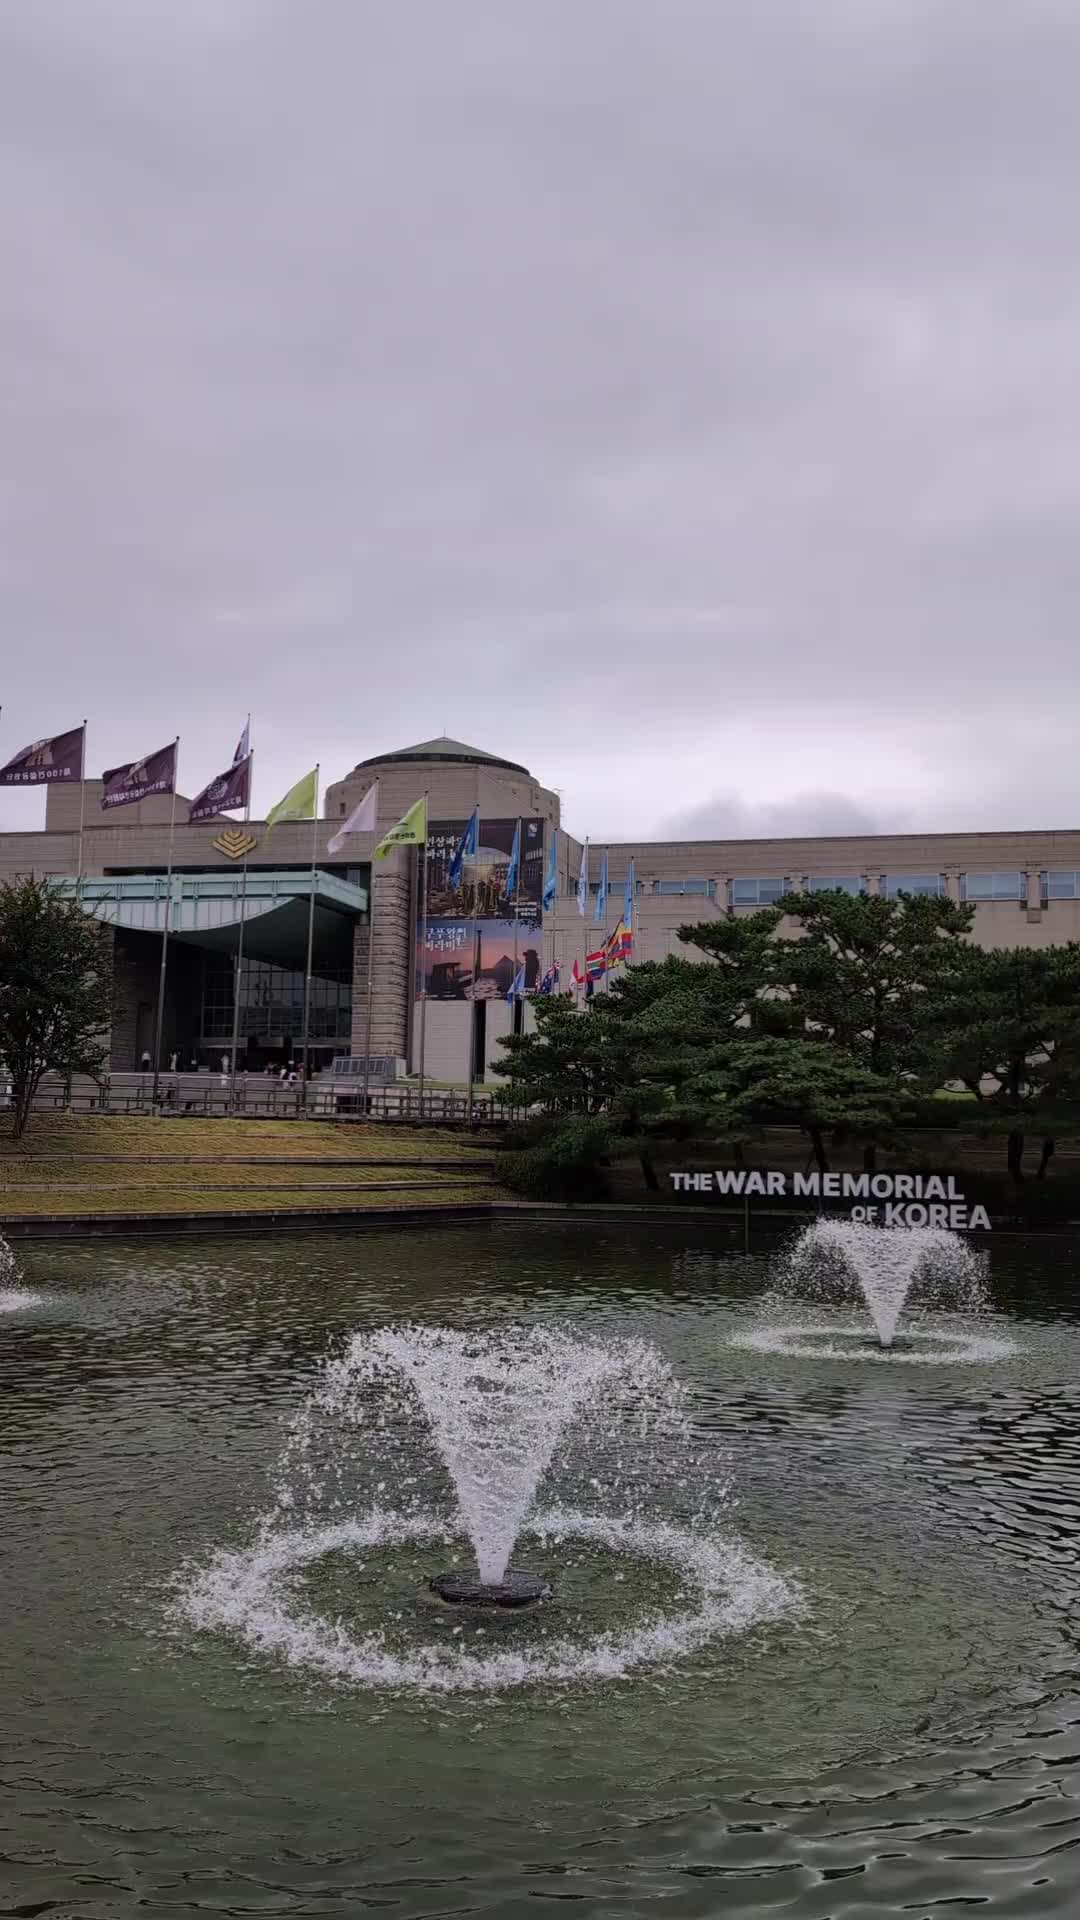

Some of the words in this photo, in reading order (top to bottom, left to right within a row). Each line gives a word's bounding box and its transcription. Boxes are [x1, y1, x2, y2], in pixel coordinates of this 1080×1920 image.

[670, 1172, 713, 1191] THE
[715, 1170, 786, 1195] WAR
[793, 1172, 965, 1200] MEMORIAL
[850, 1206, 878, 1222] OF
[884, 1202, 992, 1230] KOREA
